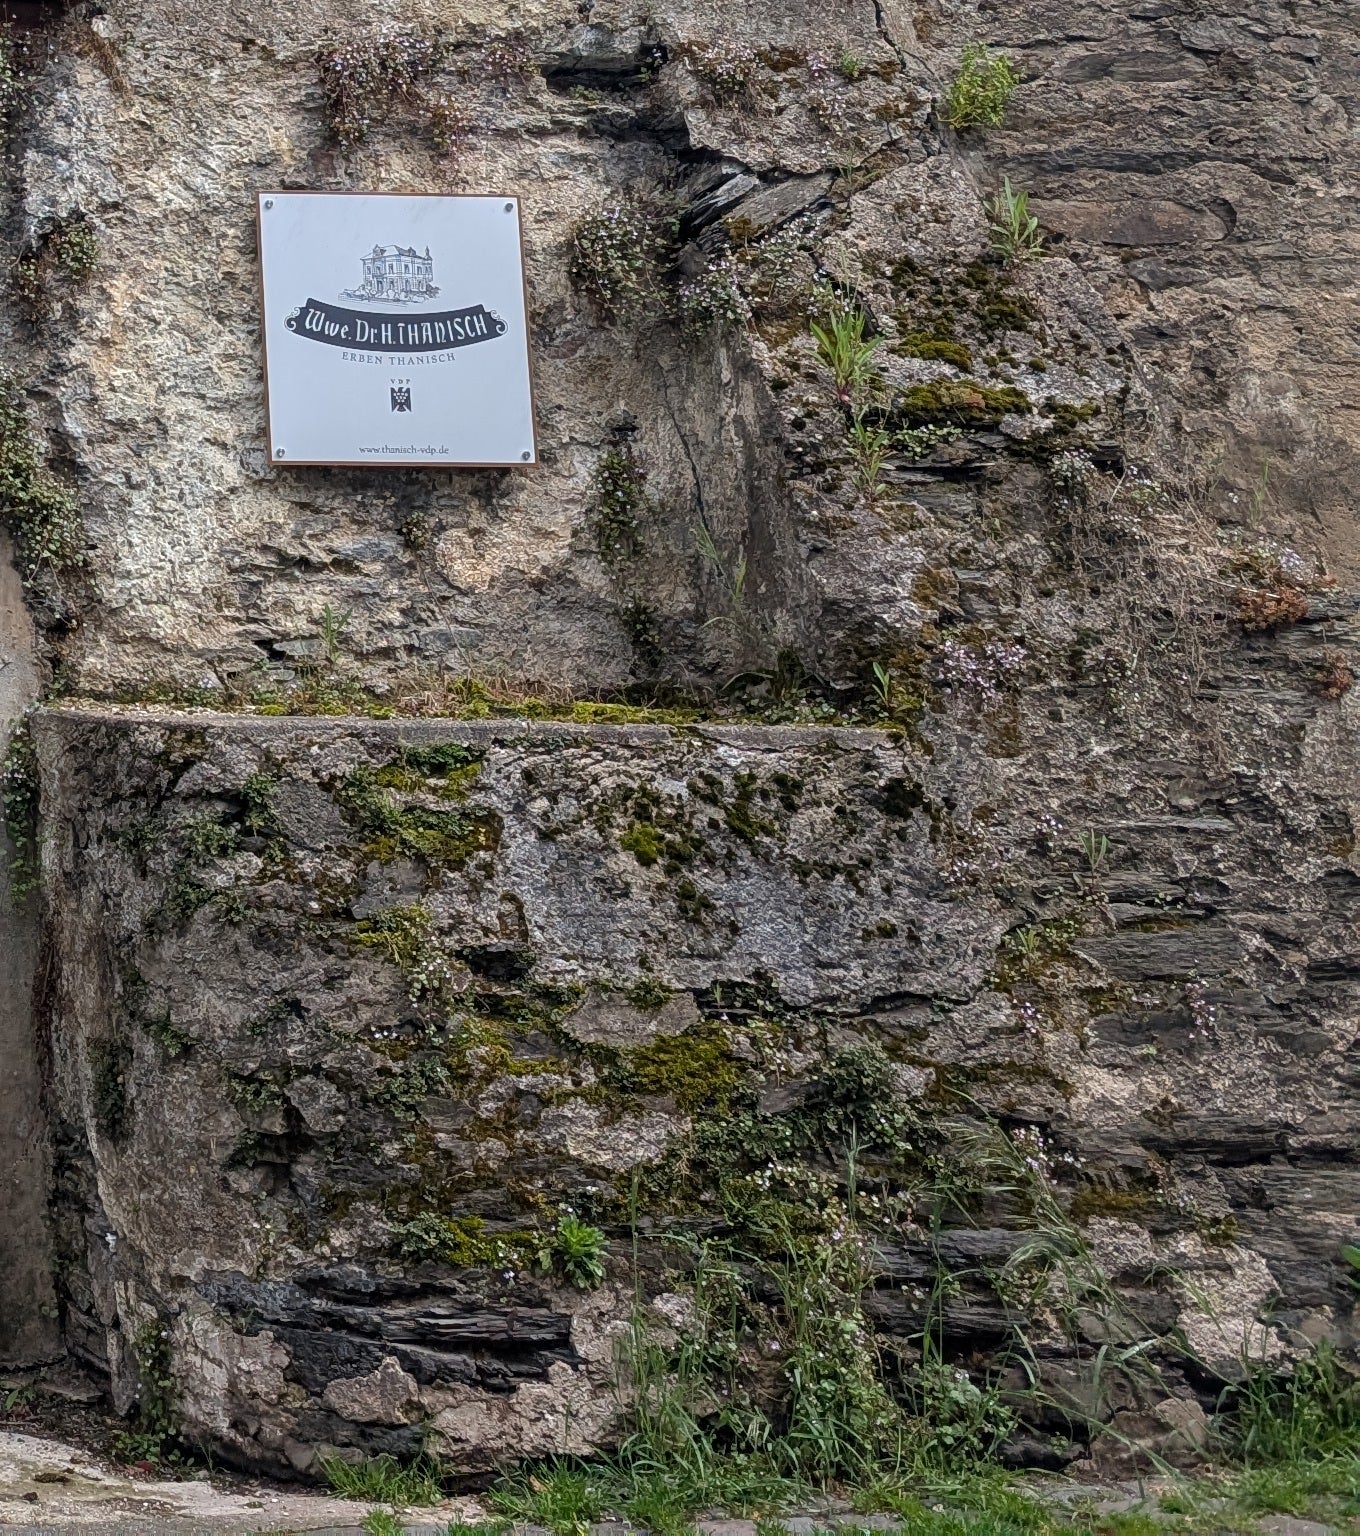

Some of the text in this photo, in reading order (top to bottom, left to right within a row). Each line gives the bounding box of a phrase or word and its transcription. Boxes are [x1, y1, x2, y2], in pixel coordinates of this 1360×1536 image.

[304, 307, 353, 341] Wwe.
[380, 323, 397, 346] H.
[397, 313, 488, 347] THANISCH
[341, 350, 457, 367] ERBEN THANISCH
[358, 444, 450, 456] www.thanisch-vdp.de
